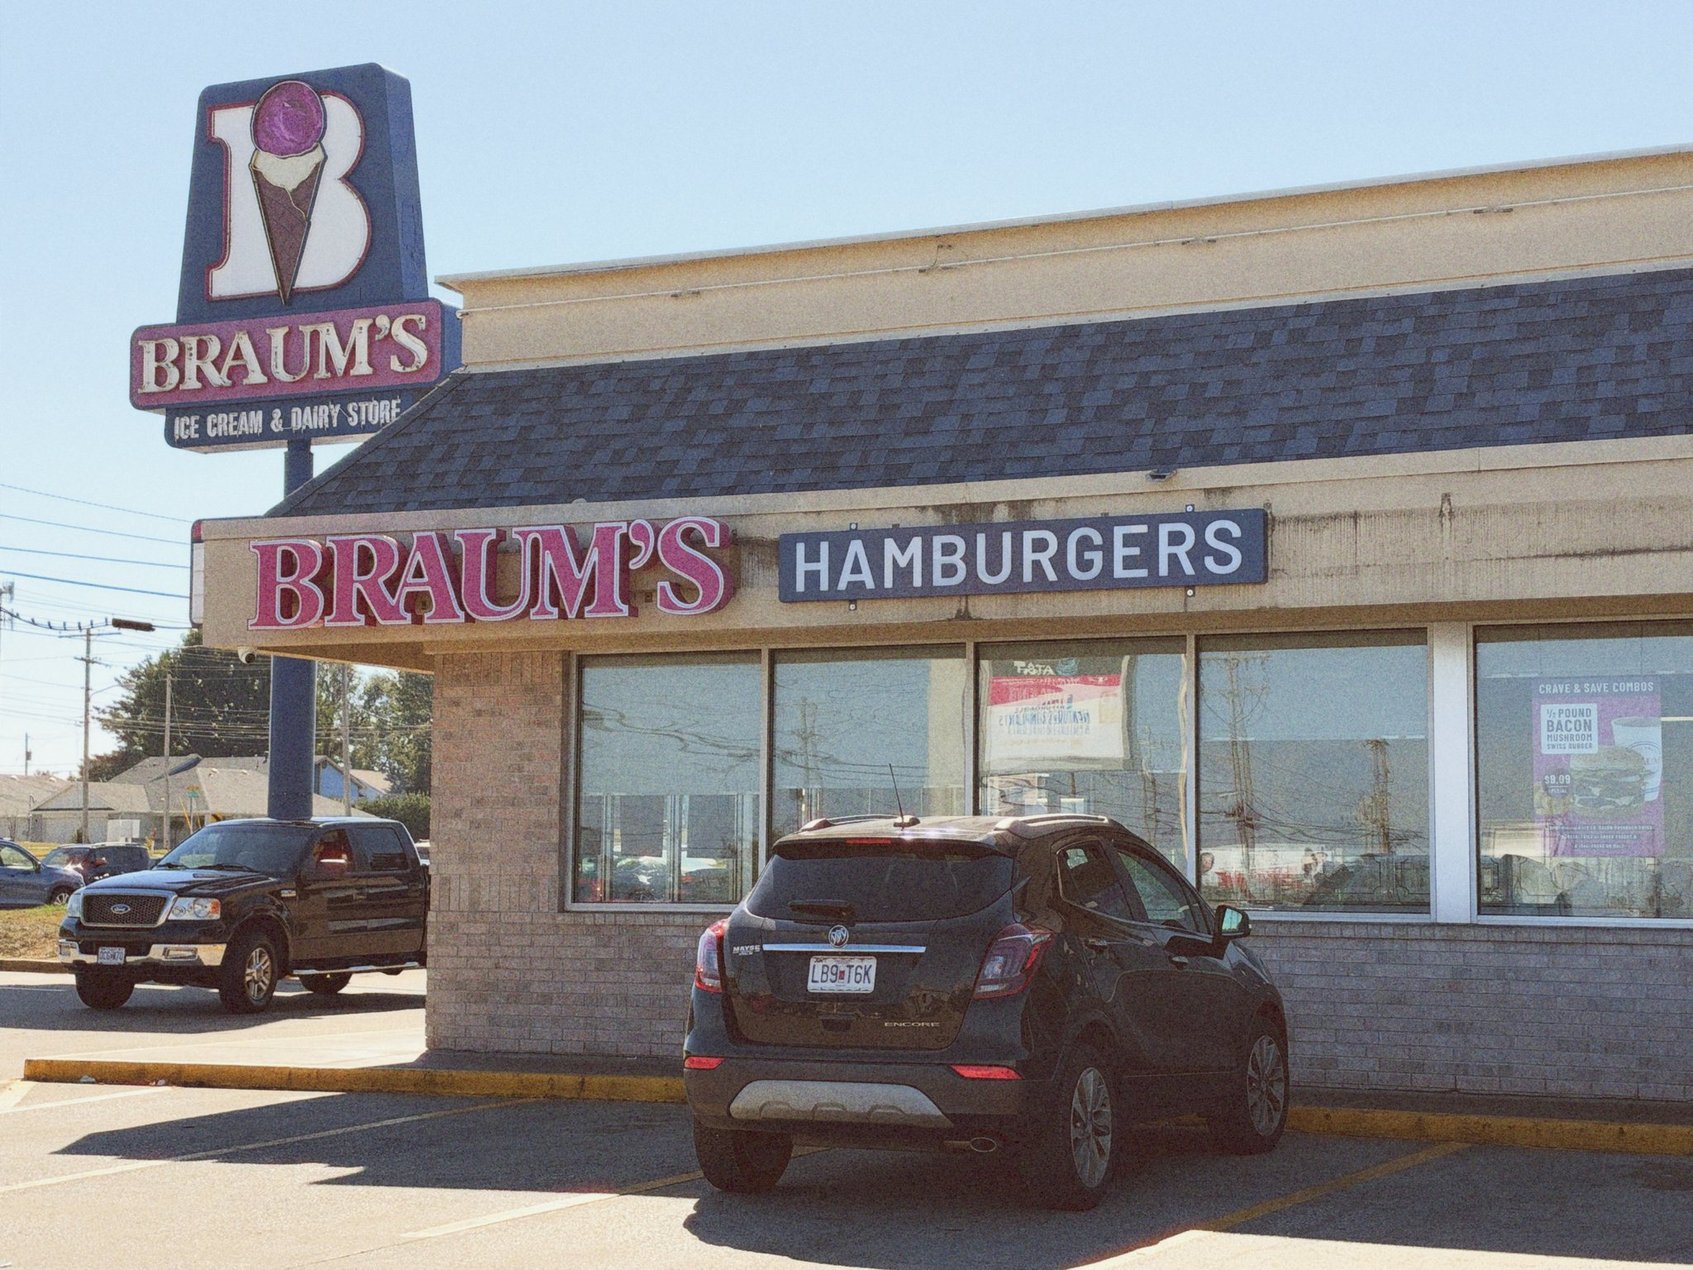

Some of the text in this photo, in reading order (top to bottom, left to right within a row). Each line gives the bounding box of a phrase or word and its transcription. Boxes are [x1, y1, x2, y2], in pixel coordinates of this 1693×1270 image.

[137, 313, 428, 394] BRAUM'S
[174, 398, 401, 441] ICE CREAM & DAIRY STORE
[795, 518, 1243, 593] HAMBURGERS
[247, 515, 729, 631] BRAUM'S
[1539, 681, 1654, 694] CRAVE & SAVE COMBOS
[1558, 707, 1592, 718] POUND
[1546, 719, 1592, 732] BACON
[1546, 733, 1593, 742] MUSHROOM
[810, 964, 873, 984] LB9 T6K
